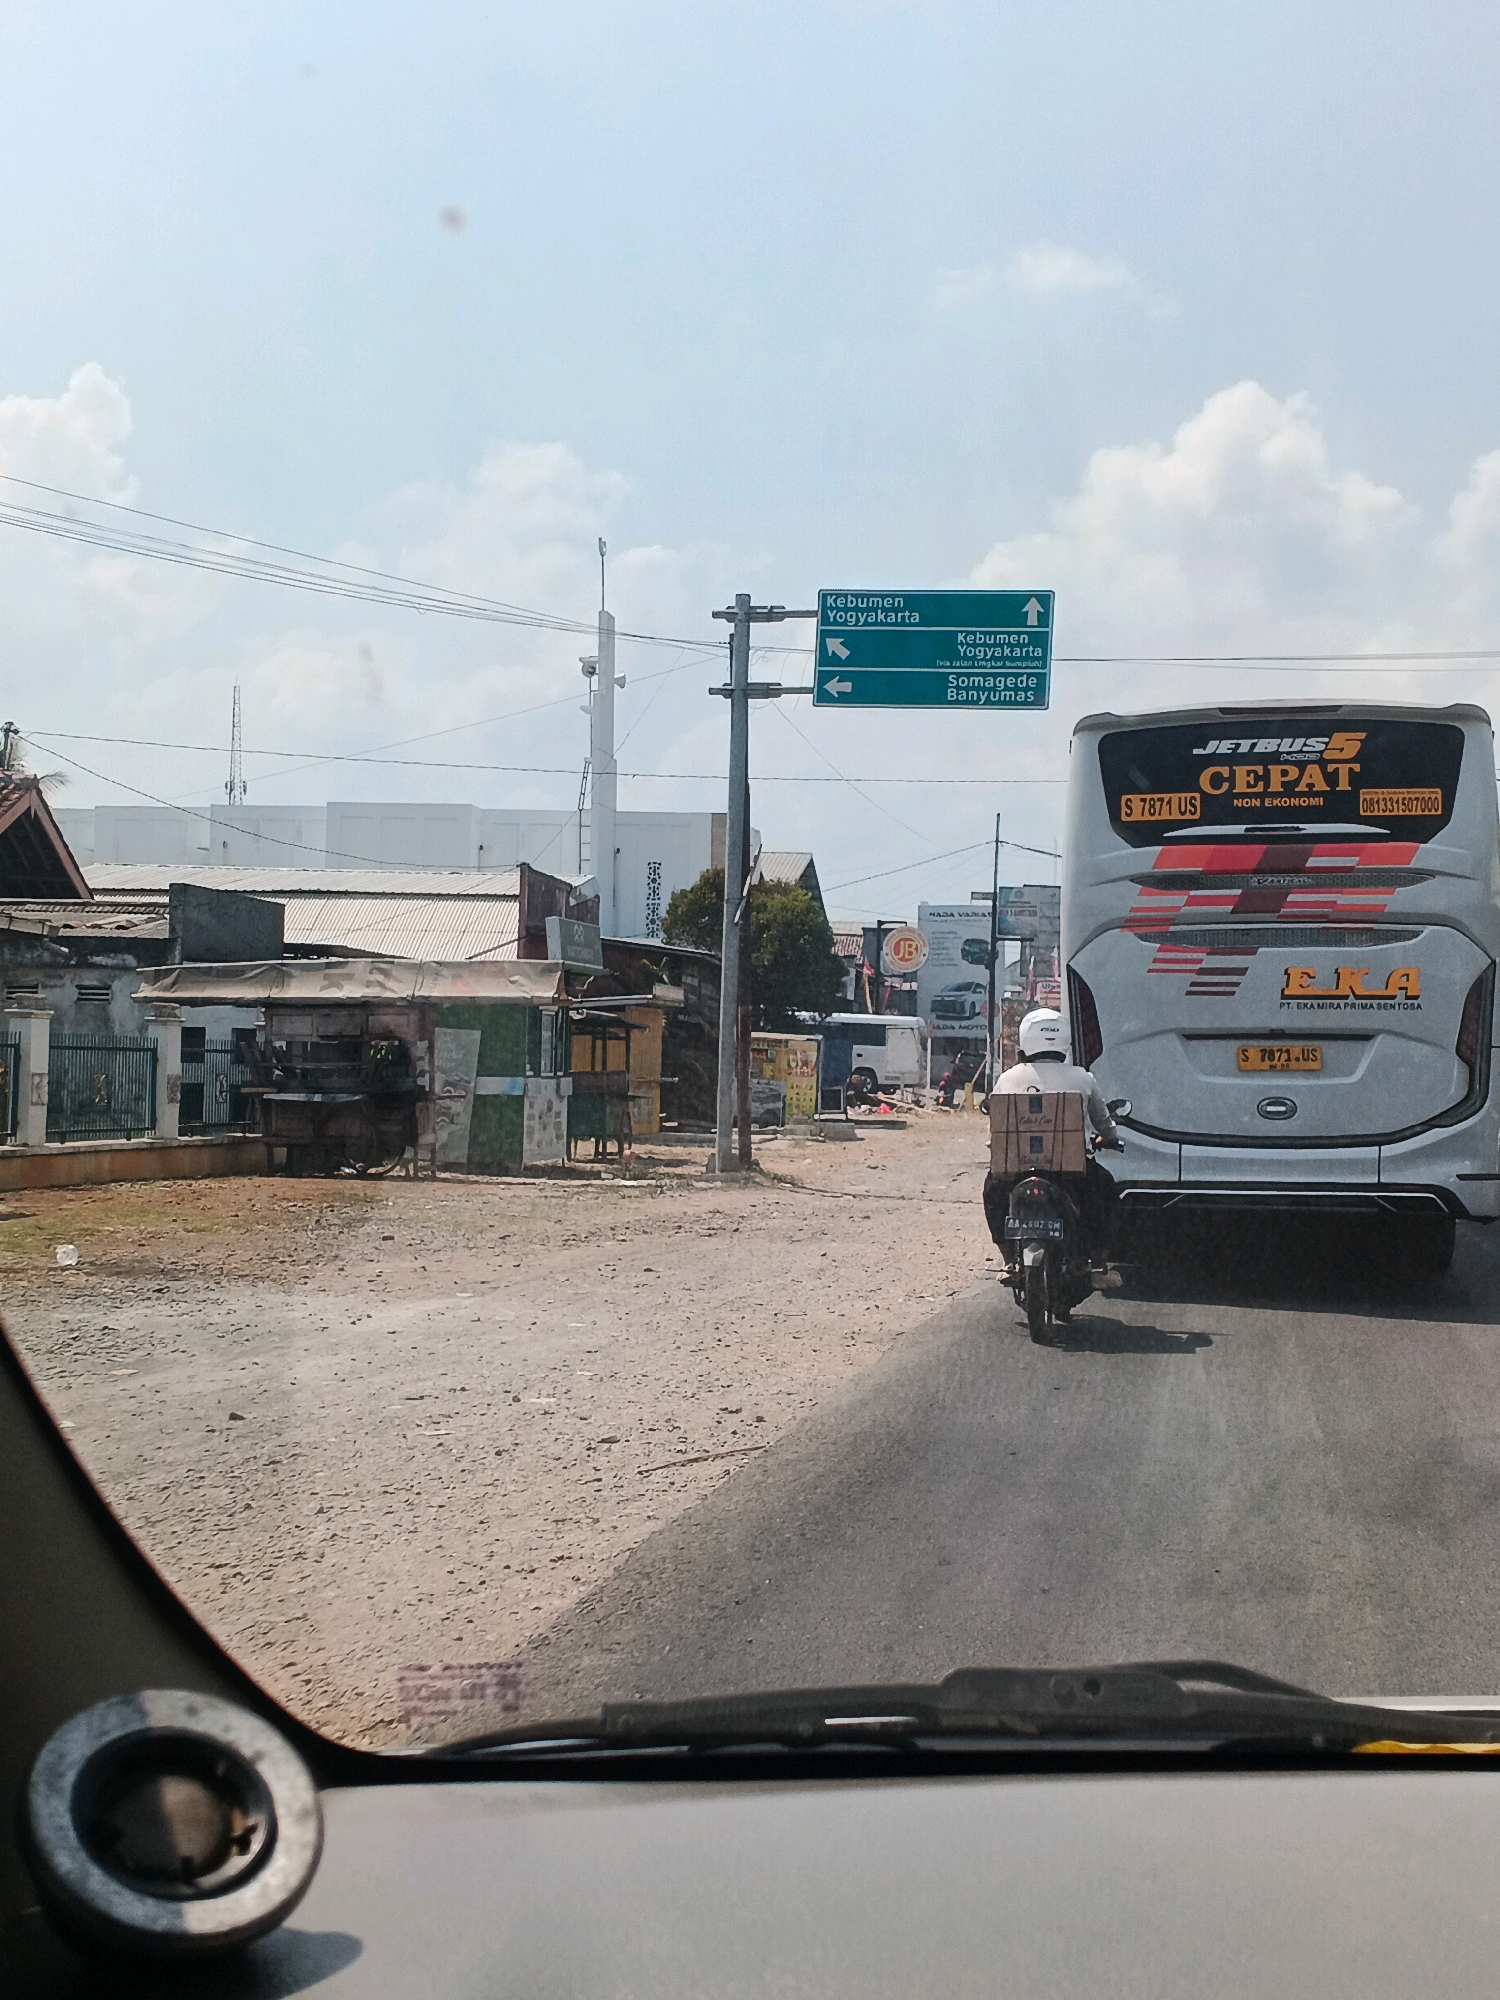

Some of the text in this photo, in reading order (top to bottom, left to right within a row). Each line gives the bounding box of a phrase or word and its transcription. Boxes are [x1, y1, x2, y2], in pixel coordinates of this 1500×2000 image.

[826, 594, 904, 608] Kebumen
[827, 609, 920, 626] Yogyakarta
[957, 632, 1029, 644] Kebumen
[957, 645, 1043, 659] Yogyakarta
[948, 674, 1037, 690] Somagede
[947, 688, 1035, 705] Banyumas
[1199, 763, 1361, 795] CEPAT
[1124, 795, 1198, 818] S 7871 US
[1233, 797, 1323, 807] NON EKONOMI
[1361, 796, 1440, 813] 081331507000
[896, 940, 917, 959] JB
[1280, 967, 1421, 1000] EKA
[1279, 1002, 1423, 1011] PT. EKA MIRA PRIMA SENTOSA
[1241, 1048, 1249, 1062] S
